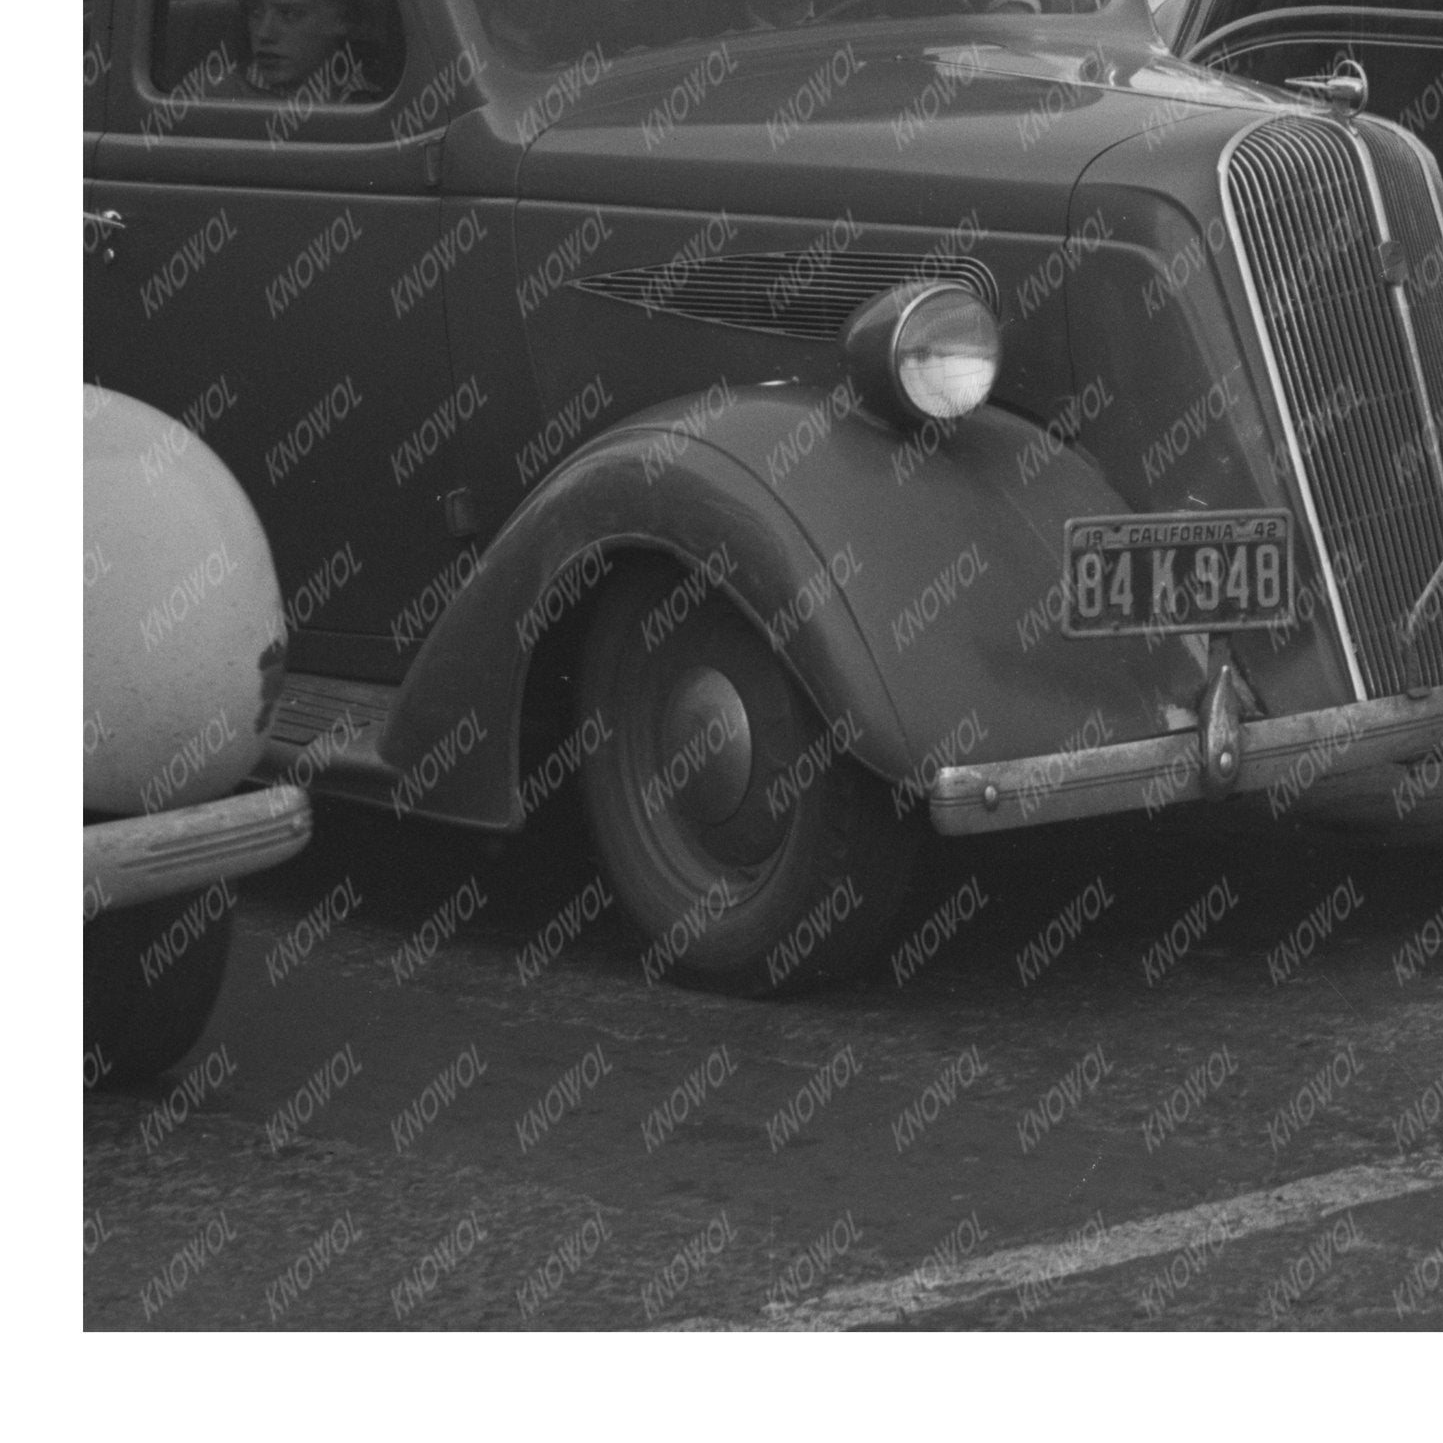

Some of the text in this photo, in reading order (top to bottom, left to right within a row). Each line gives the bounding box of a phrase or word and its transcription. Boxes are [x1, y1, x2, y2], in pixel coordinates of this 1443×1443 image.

[1129, 523, 1235, 544] CALIFORNIA
[1253, 521, 1278, 537] 42
[1077, 544, 1281, 618] 84 K 948
